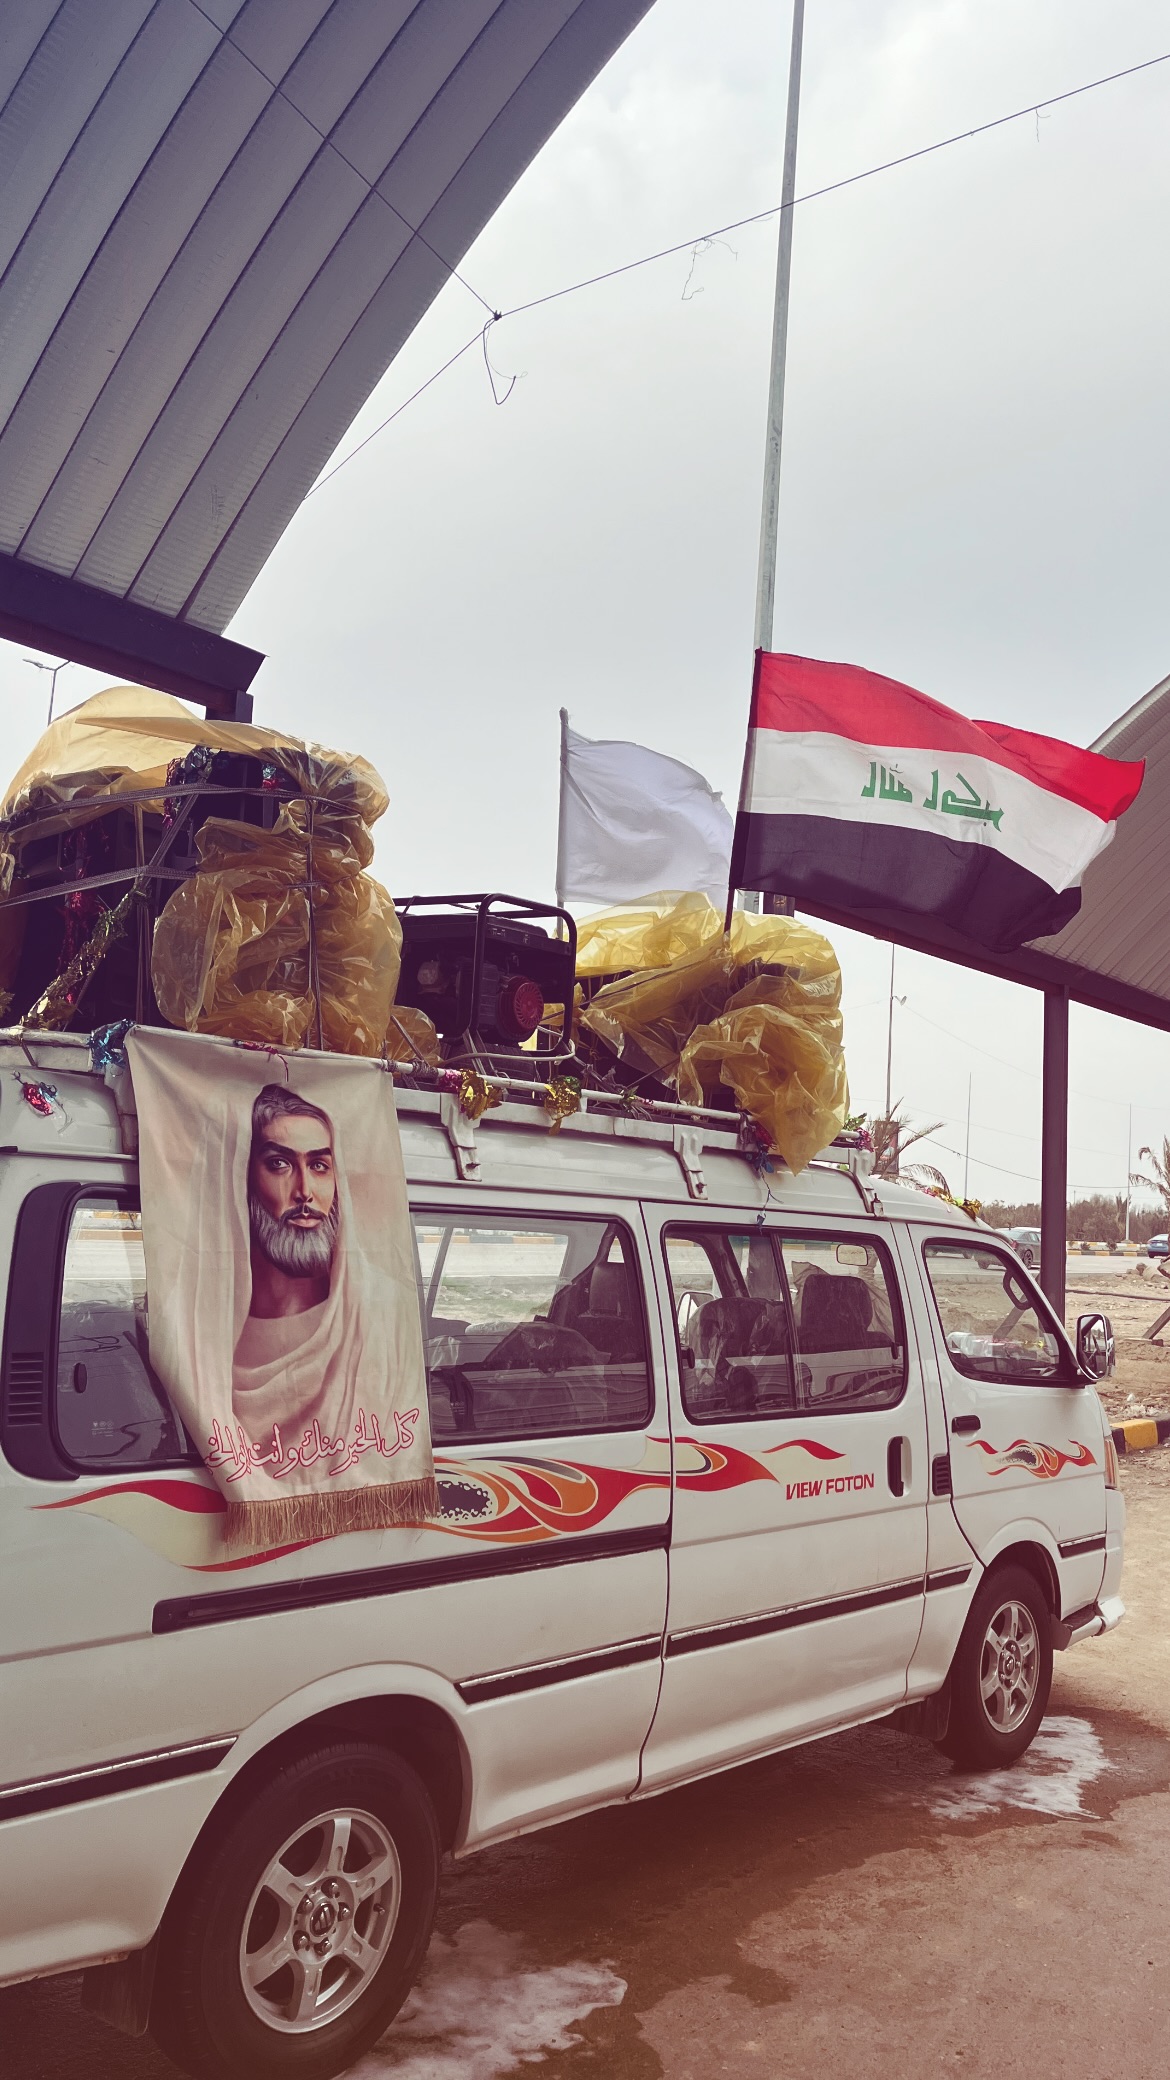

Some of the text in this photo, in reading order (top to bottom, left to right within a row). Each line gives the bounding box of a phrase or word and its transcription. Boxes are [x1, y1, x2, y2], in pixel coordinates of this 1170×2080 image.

[300, 1418, 345, 1467] منك
[329, 1408, 382, 1476] الخير
[381, 1408, 420, 1457] كل
[786, 1473, 874, 1500] VIEW FOTON
